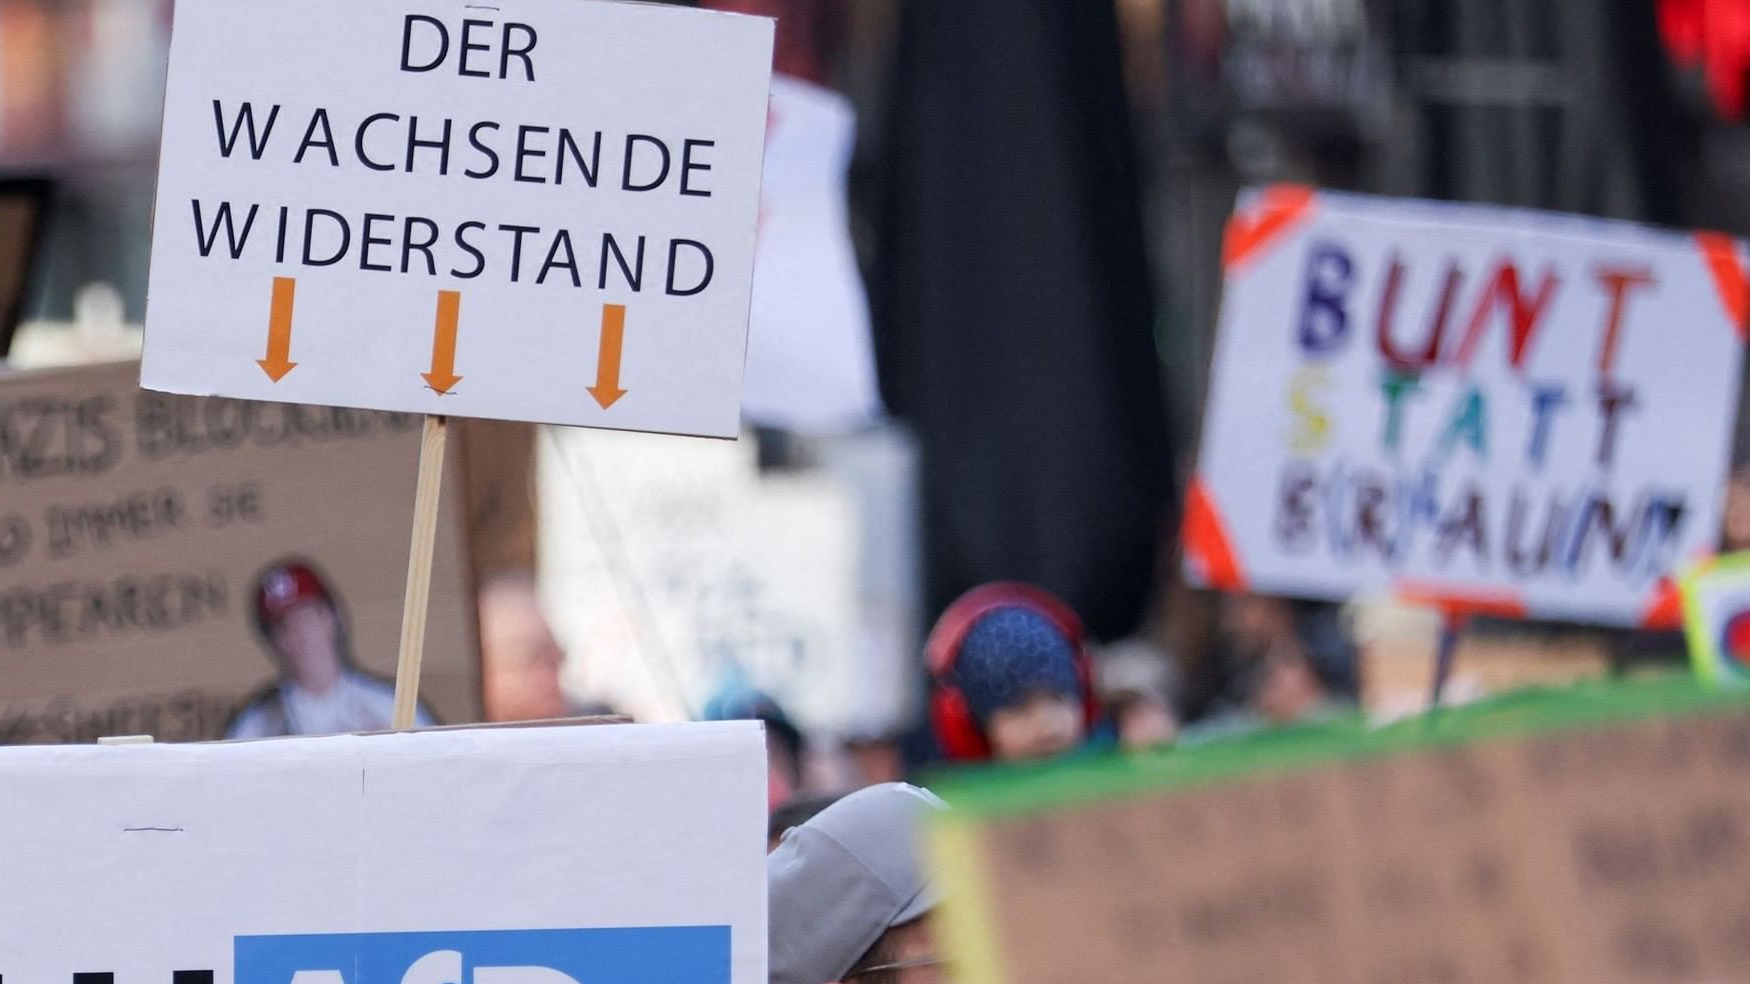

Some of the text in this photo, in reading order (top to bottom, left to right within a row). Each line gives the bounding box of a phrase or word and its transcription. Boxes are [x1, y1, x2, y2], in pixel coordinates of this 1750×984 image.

[400, 14, 538, 82] DER
[212, 99, 715, 197] WACHSENDE
[191, 199, 714, 297] WIDERSTAND
[1295, 240, 1662, 376] BUNT
[1280, 362, 1644, 466] STATT
[46, 486, 185, 560] IMMER
